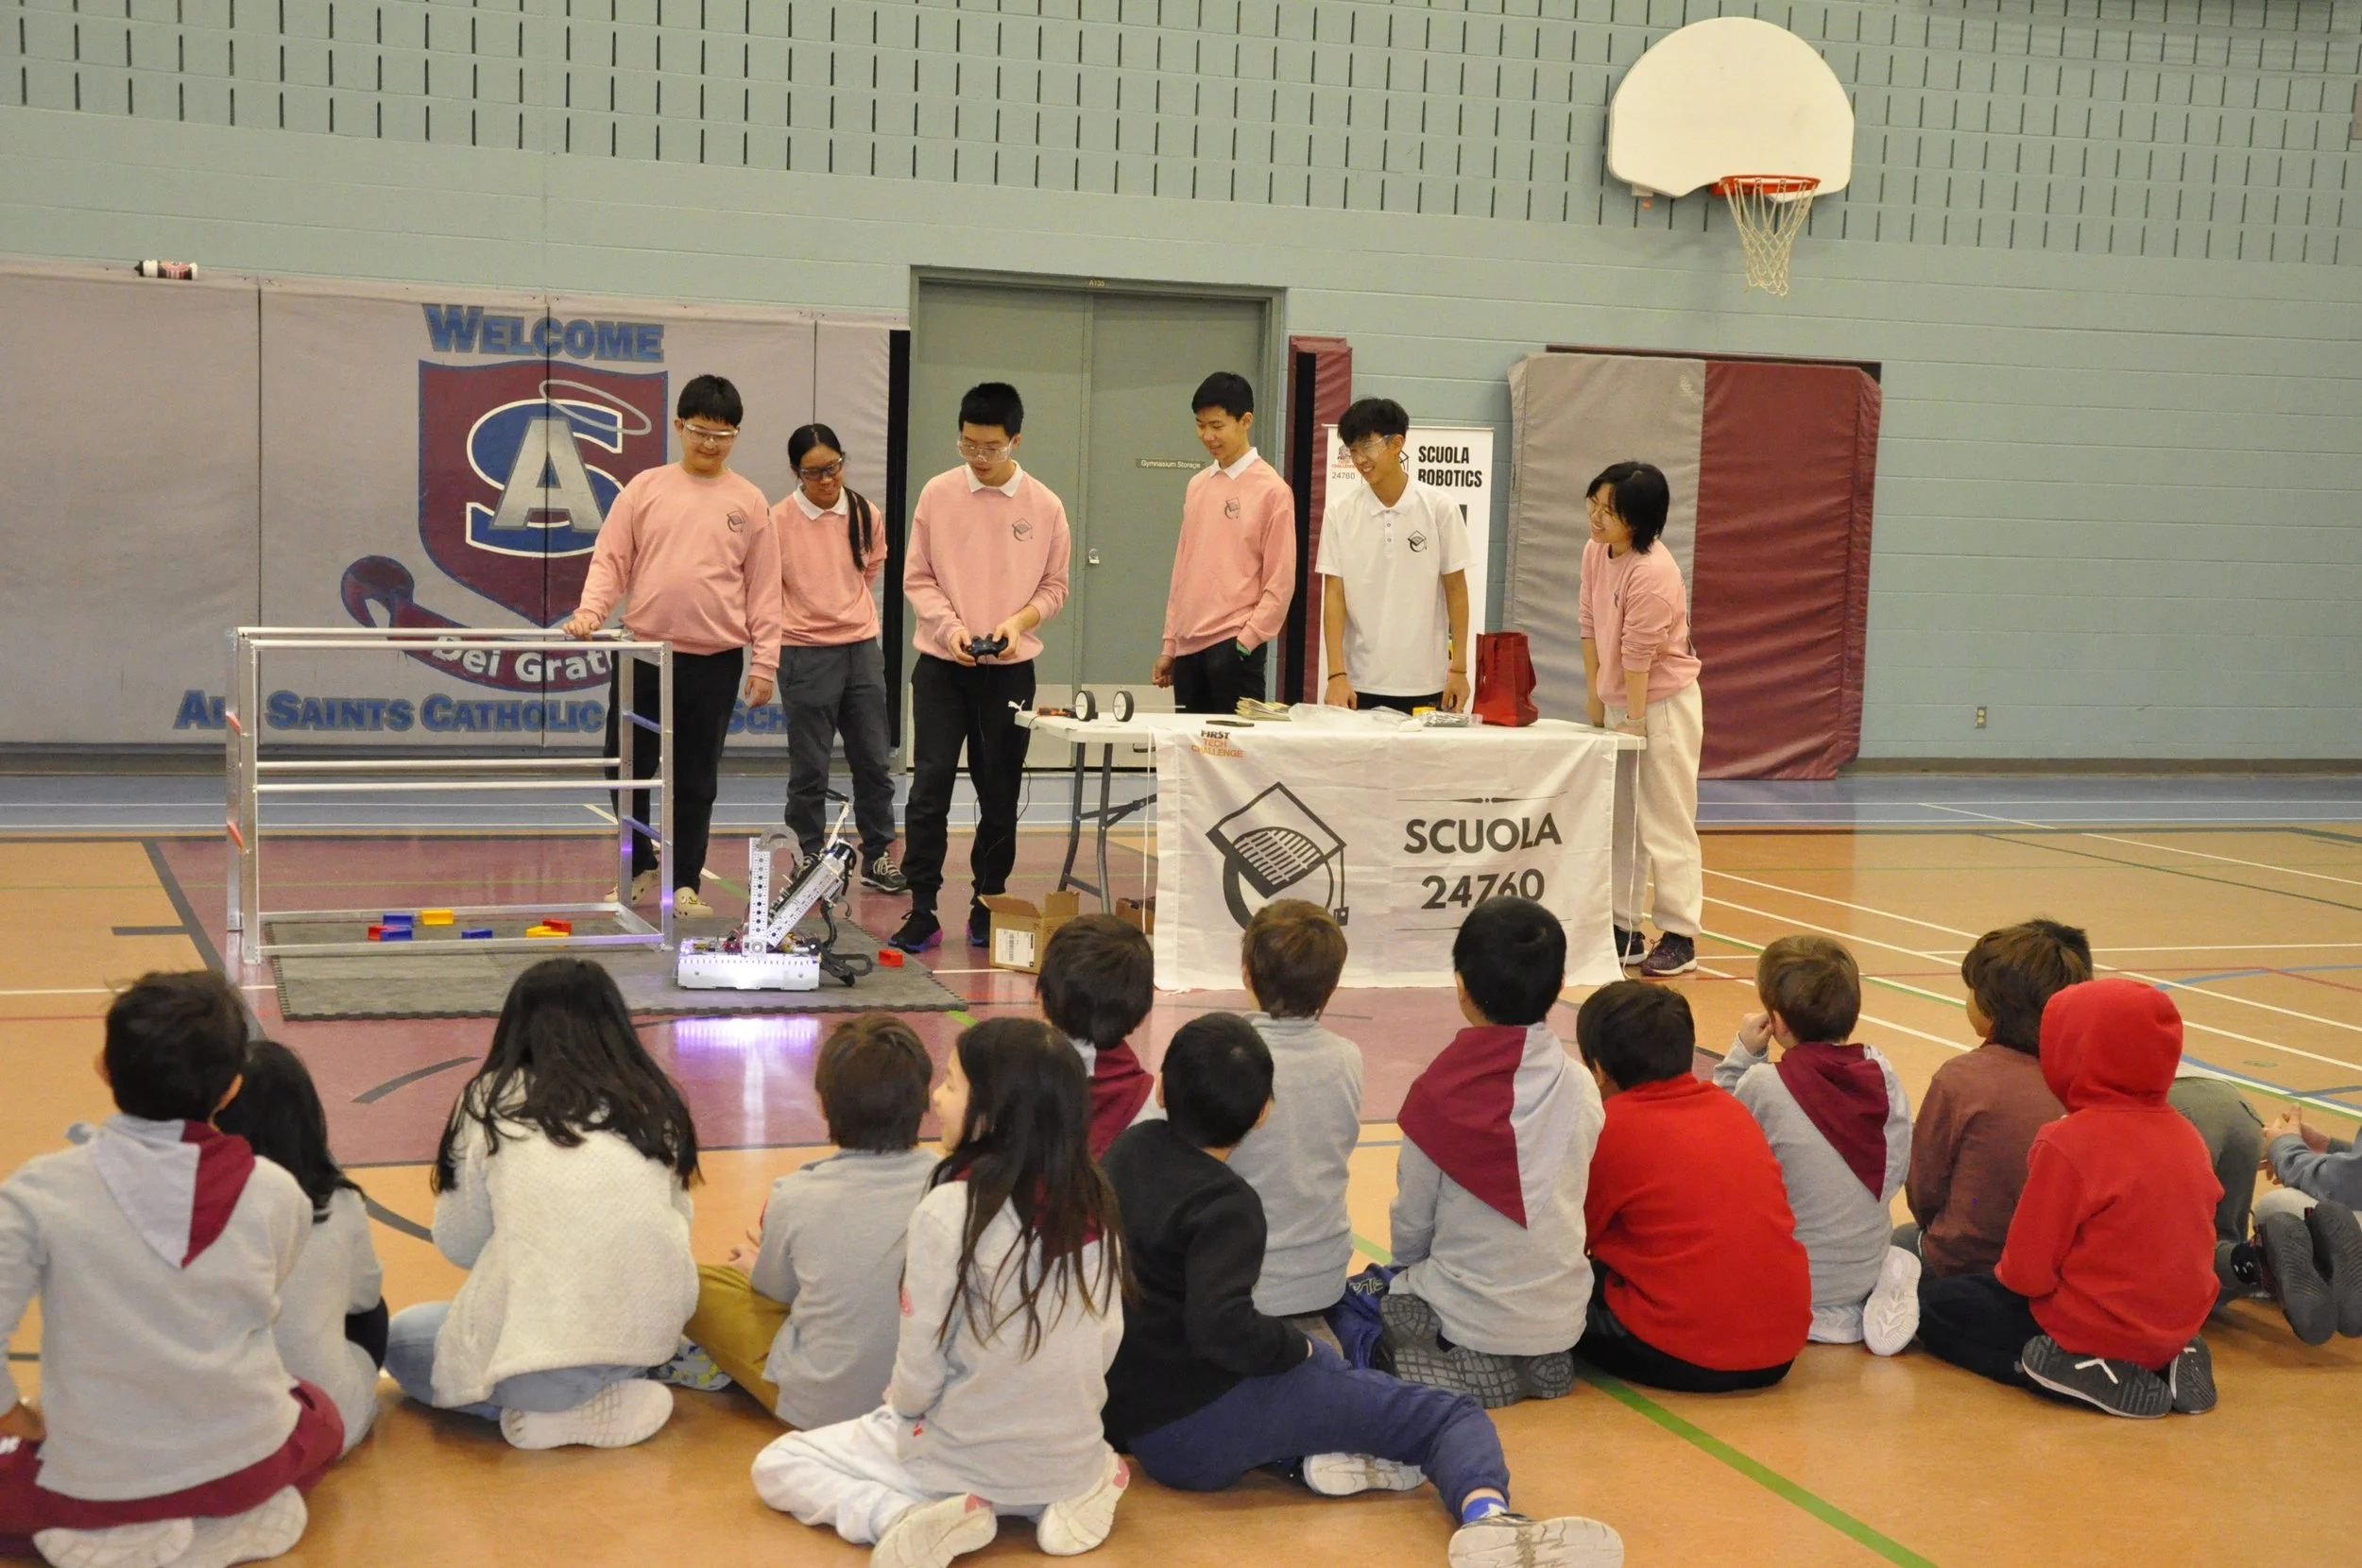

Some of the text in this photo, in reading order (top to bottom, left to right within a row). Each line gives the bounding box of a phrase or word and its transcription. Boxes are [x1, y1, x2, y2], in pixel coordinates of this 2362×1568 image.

[421, 303, 665, 364] WELCOME
[1418, 445, 1469, 464] SCUOLA
[1140, 459, 1202, 469] Gymnasium Storage
[1418, 469, 1482, 487] ROBOTICS
[265, 690, 416, 733] SAINTS
[419, 692, 607, 733] CATHOLIC
[1201, 730, 1231, 740] FIRST
[1203, 738, 1227, 748] TECH
[1191, 744, 1244, 758] CHALLENGE
[1403, 812, 1563, 854] SCUOLA
[1420, 868, 1546, 910] 24760
